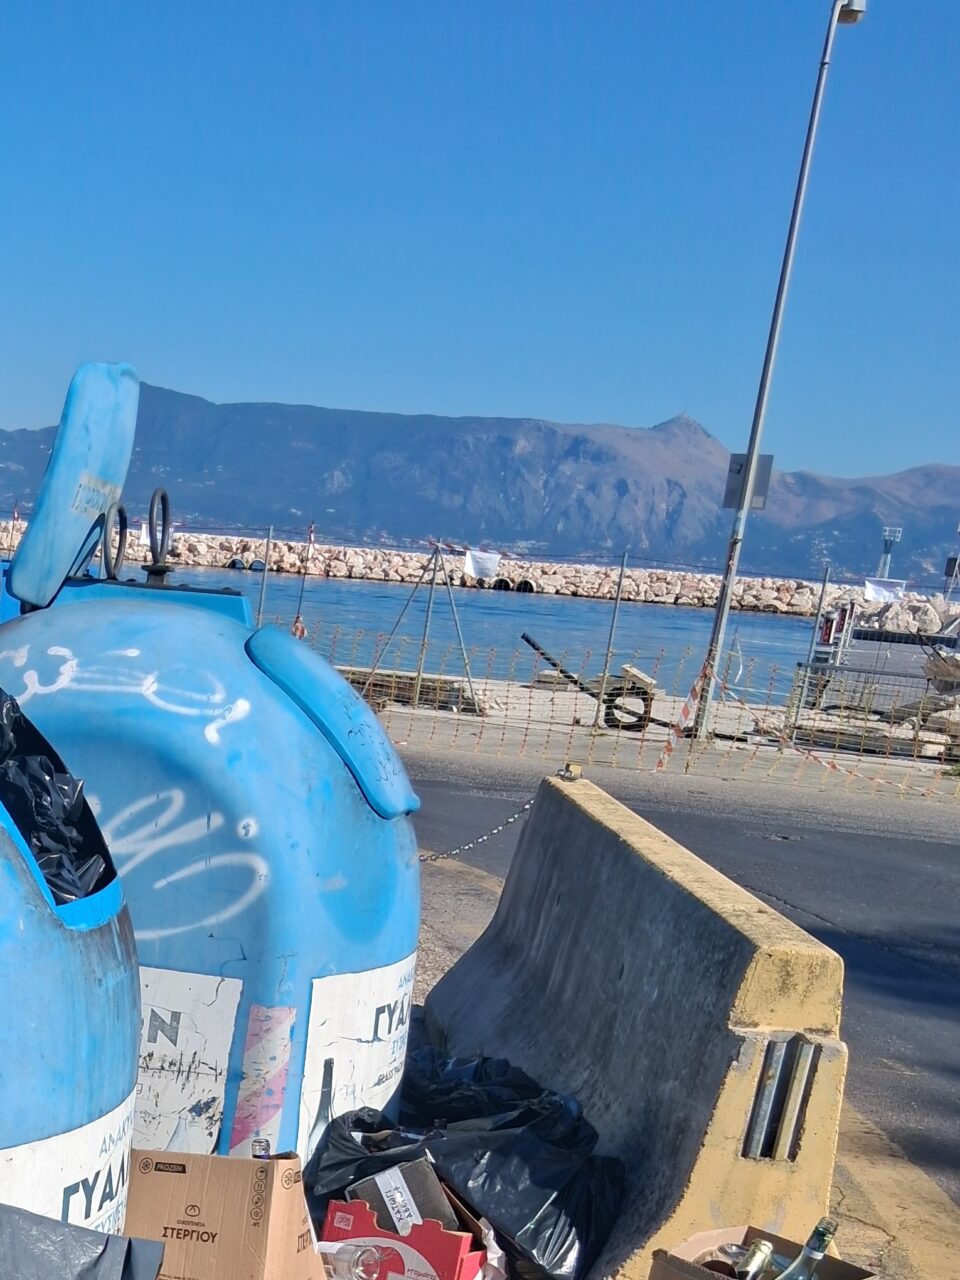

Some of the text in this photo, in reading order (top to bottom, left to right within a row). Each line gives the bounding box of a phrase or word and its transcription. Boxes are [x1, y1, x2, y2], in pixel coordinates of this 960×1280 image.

[140, 1007, 182, 1048] Ν
[373, 993, 411, 1040] ΓΥΑΛ
[161, 1226, 218, 1243] ΣΤΕΡΓΙΟΥ
